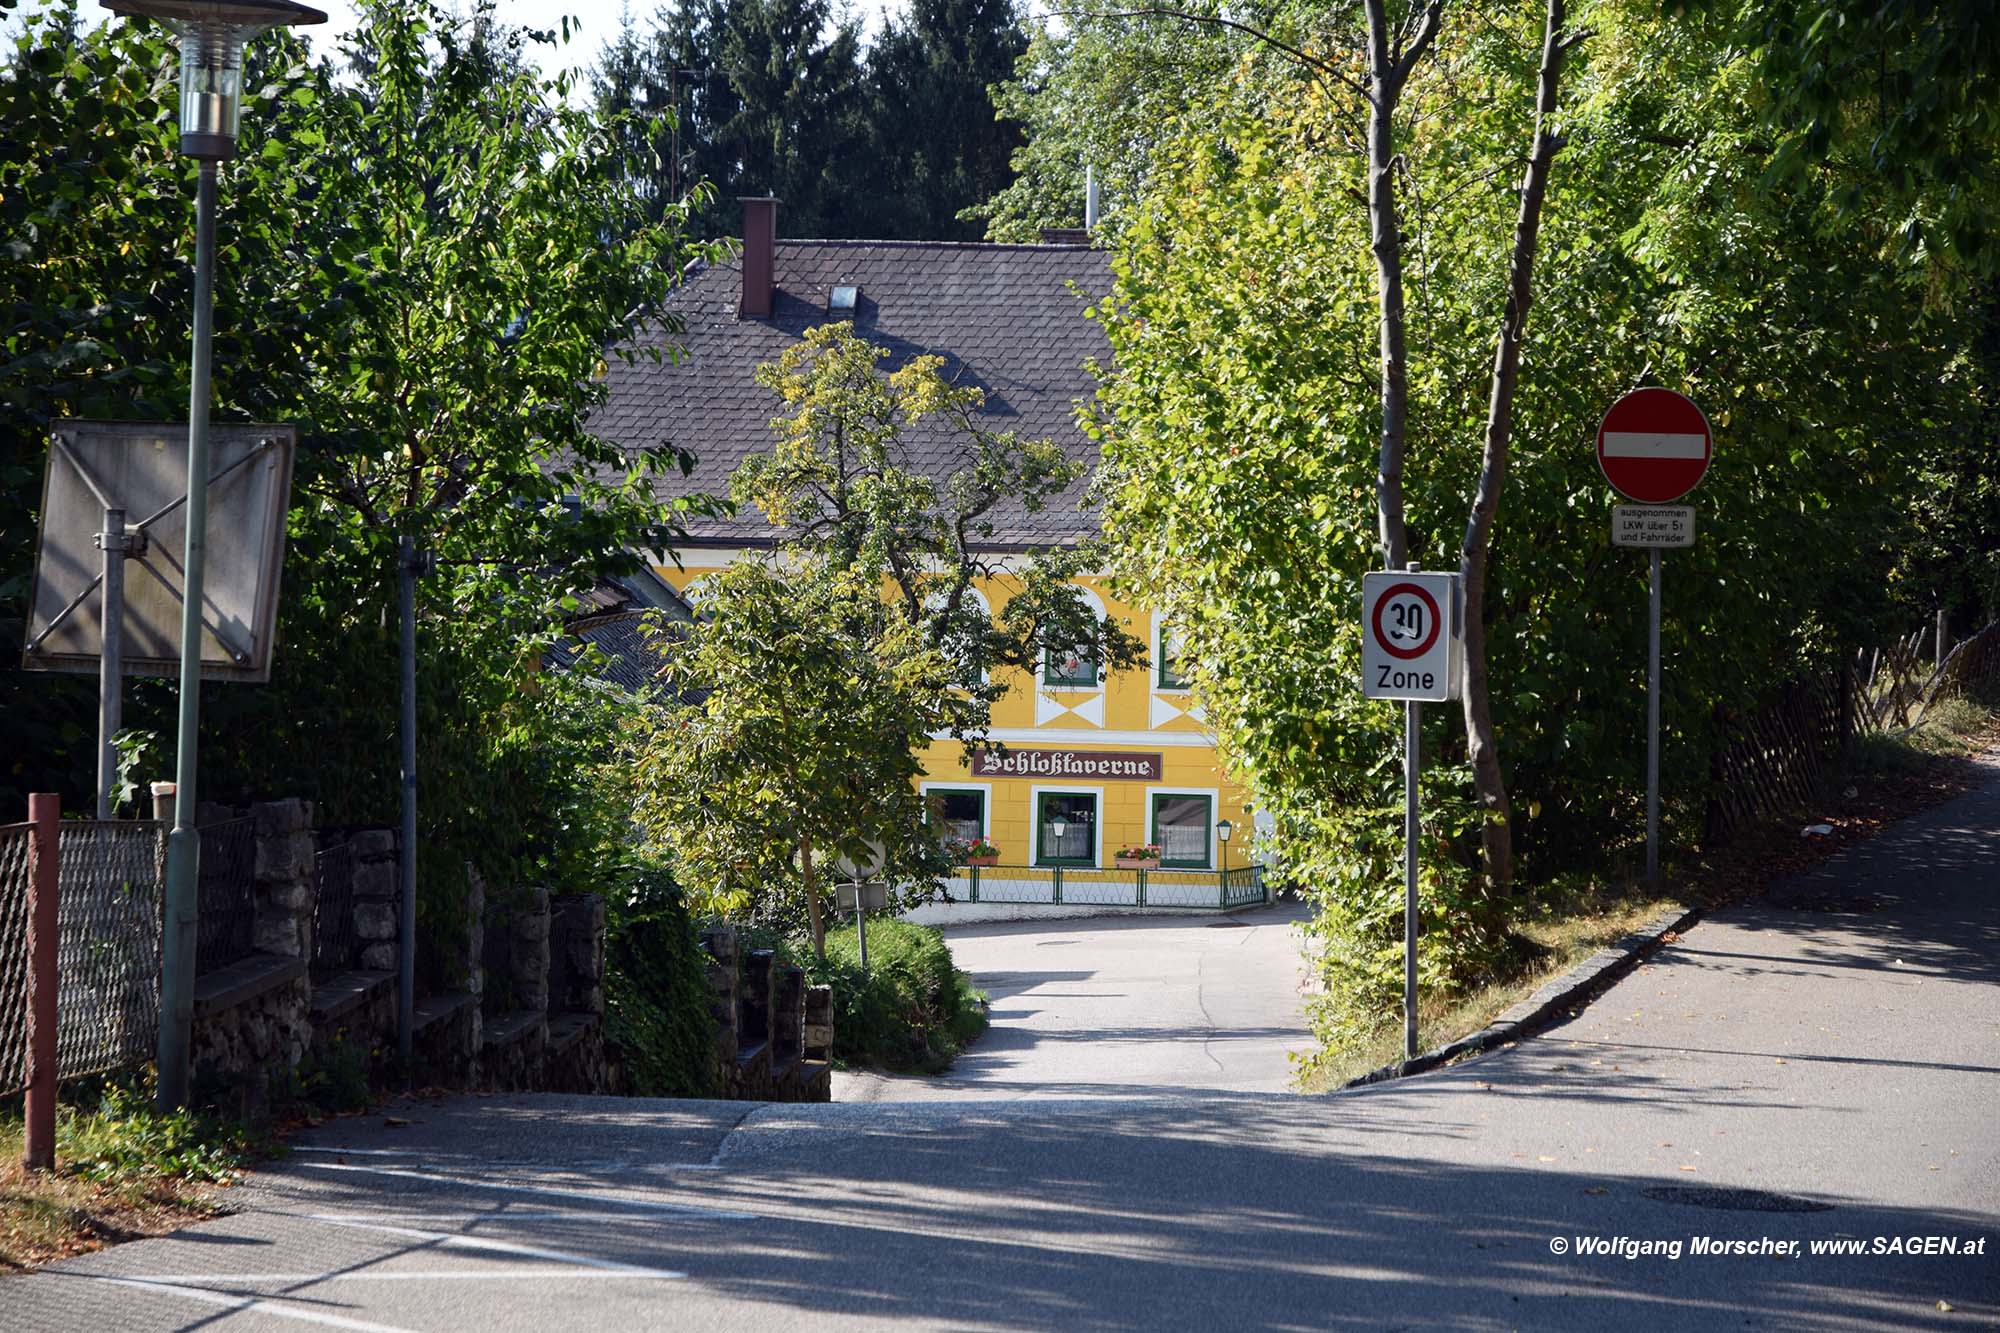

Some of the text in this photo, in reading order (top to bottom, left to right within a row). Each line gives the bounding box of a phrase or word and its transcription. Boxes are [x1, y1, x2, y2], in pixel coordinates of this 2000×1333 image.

[1620, 509, 1688, 519] ausgenommen
[1623, 520, 1644, 530] LKW
[1647, 520, 1668, 531] über
[1620, 533, 1686, 543] und Fahrräder
[1390, 603, 1422, 640] 30
[1377, 665, 1434, 690] Zone
[979, 751, 1154, 777] Schloßtaverne
